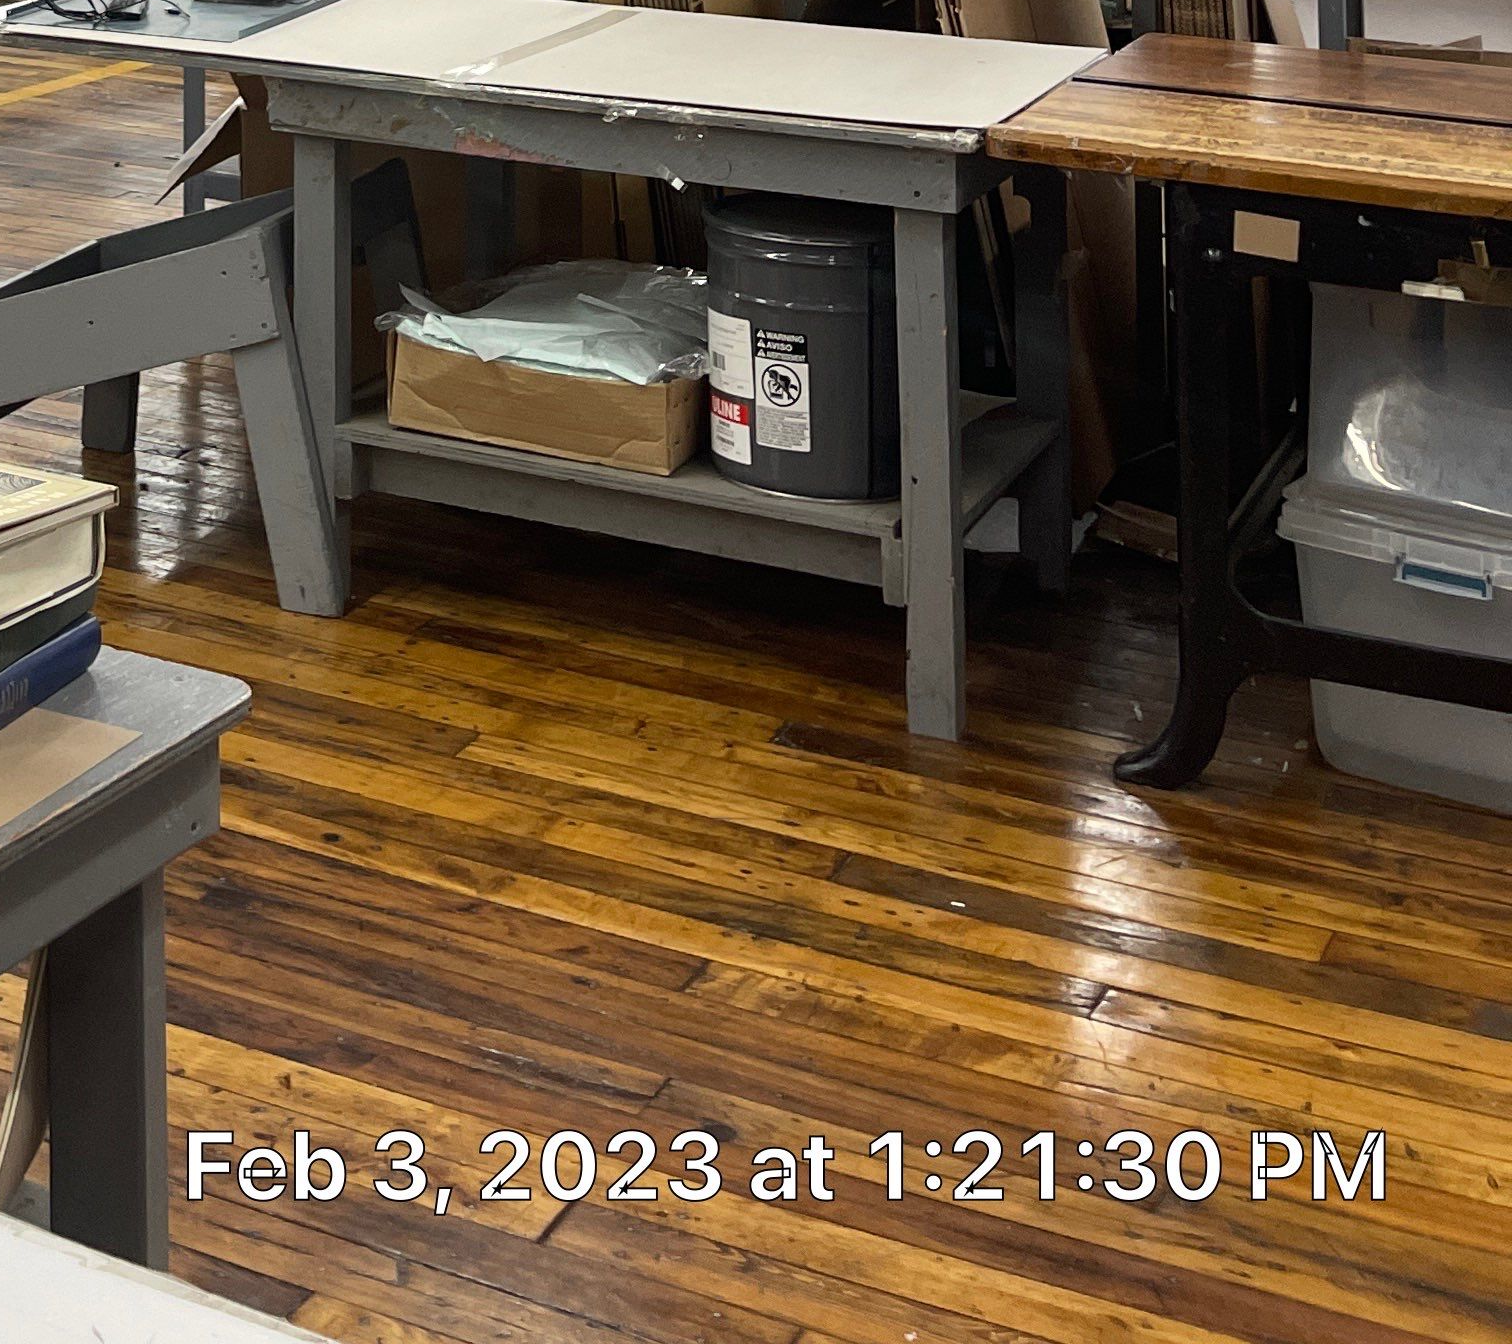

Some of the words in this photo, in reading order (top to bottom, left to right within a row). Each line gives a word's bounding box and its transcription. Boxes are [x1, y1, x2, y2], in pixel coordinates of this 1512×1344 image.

[765, 332, 805, 344] WARNING
[766, 341, 793, 352] AVISO
[711, 395, 741, 421] ULINE
